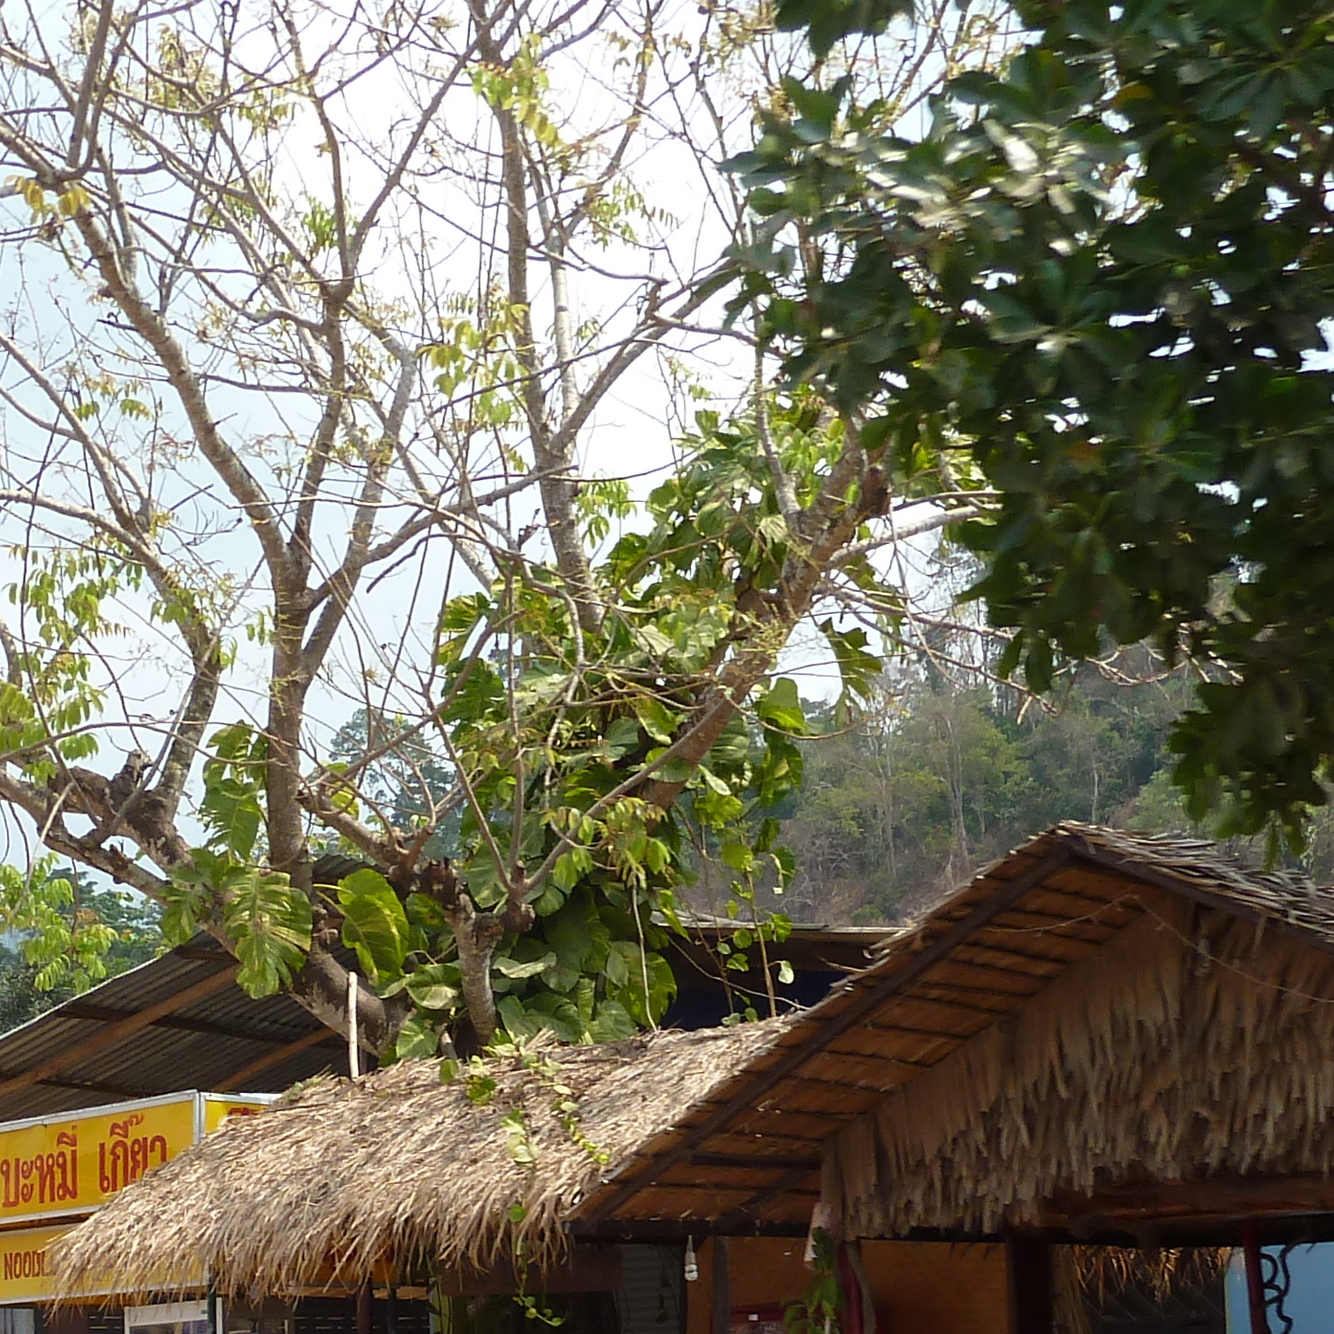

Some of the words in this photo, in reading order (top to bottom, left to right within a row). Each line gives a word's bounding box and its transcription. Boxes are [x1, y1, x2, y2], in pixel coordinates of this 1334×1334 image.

[0, 1125, 78, 1208] บะหมี่
[3, 1249, 55, 1281] NOODL
